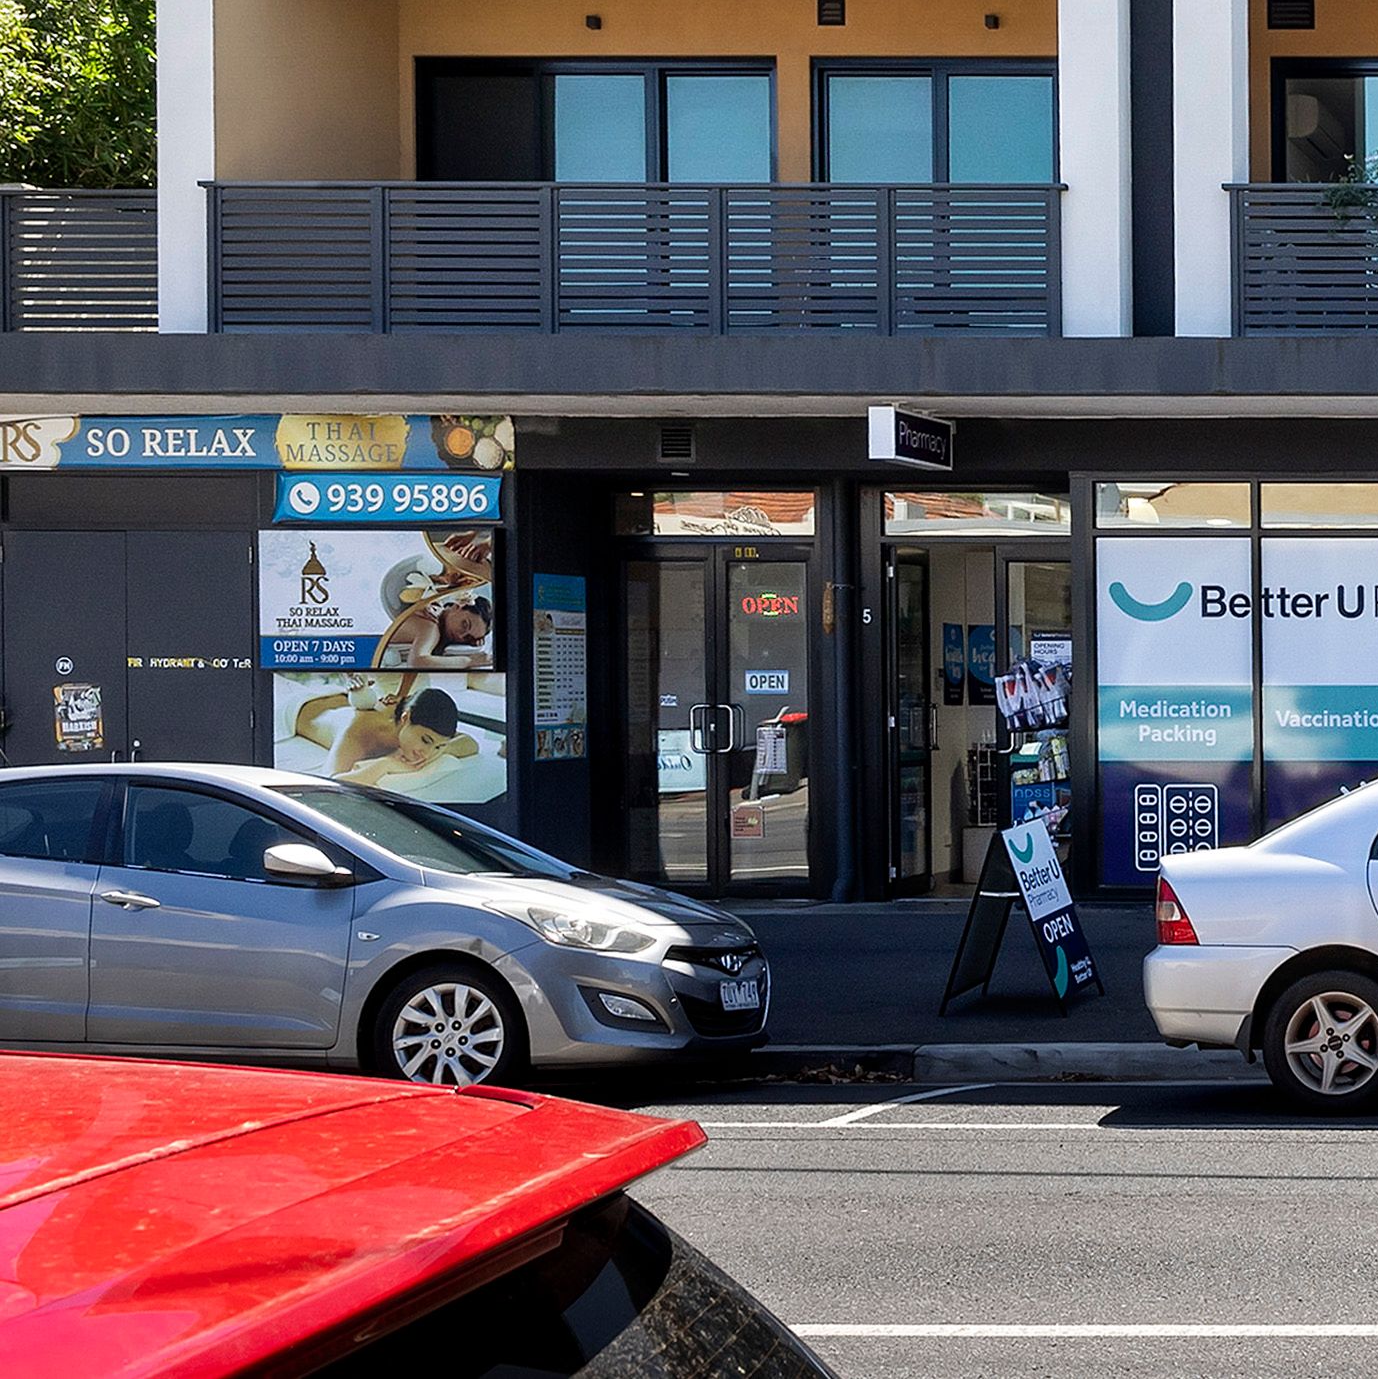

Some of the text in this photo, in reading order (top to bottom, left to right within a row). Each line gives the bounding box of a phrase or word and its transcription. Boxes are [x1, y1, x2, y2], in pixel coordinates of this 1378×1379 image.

[307, 422, 377, 442] THAI
[899, 420, 947, 461] Pharmacy
[87, 429, 257, 457] SO RELAX
[286, 443, 400, 463] MASSAGE
[327, 484, 488, 513] 939 95896
[299, 576, 330, 604] RS
[289, 607, 339, 617] SO RELAX
[741, 596, 799, 615] OPEN
[1201, 585, 1329, 619] Better
[1337, 585, 1365, 620] U
[276, 618, 354, 628] THAI MASSAGE
[863, 609, 872, 623] 5
[273, 641, 355, 652] OPEN 7 DAYS
[150, 658, 195, 668] HYDRANT
[275, 655, 298, 663] 10:00
[320, 655, 339, 663] 9:00
[340, 656, 355, 665] pm
[749, 675, 785, 689] OPEN
[1120, 700, 1231, 718] Medication
[1139, 725, 1217, 746] Packing
[1020, 858, 1060, 892] Better U
[1027, 887, 1060, 909] Pharmacy
[1043, 913, 1075, 943] OPEN
